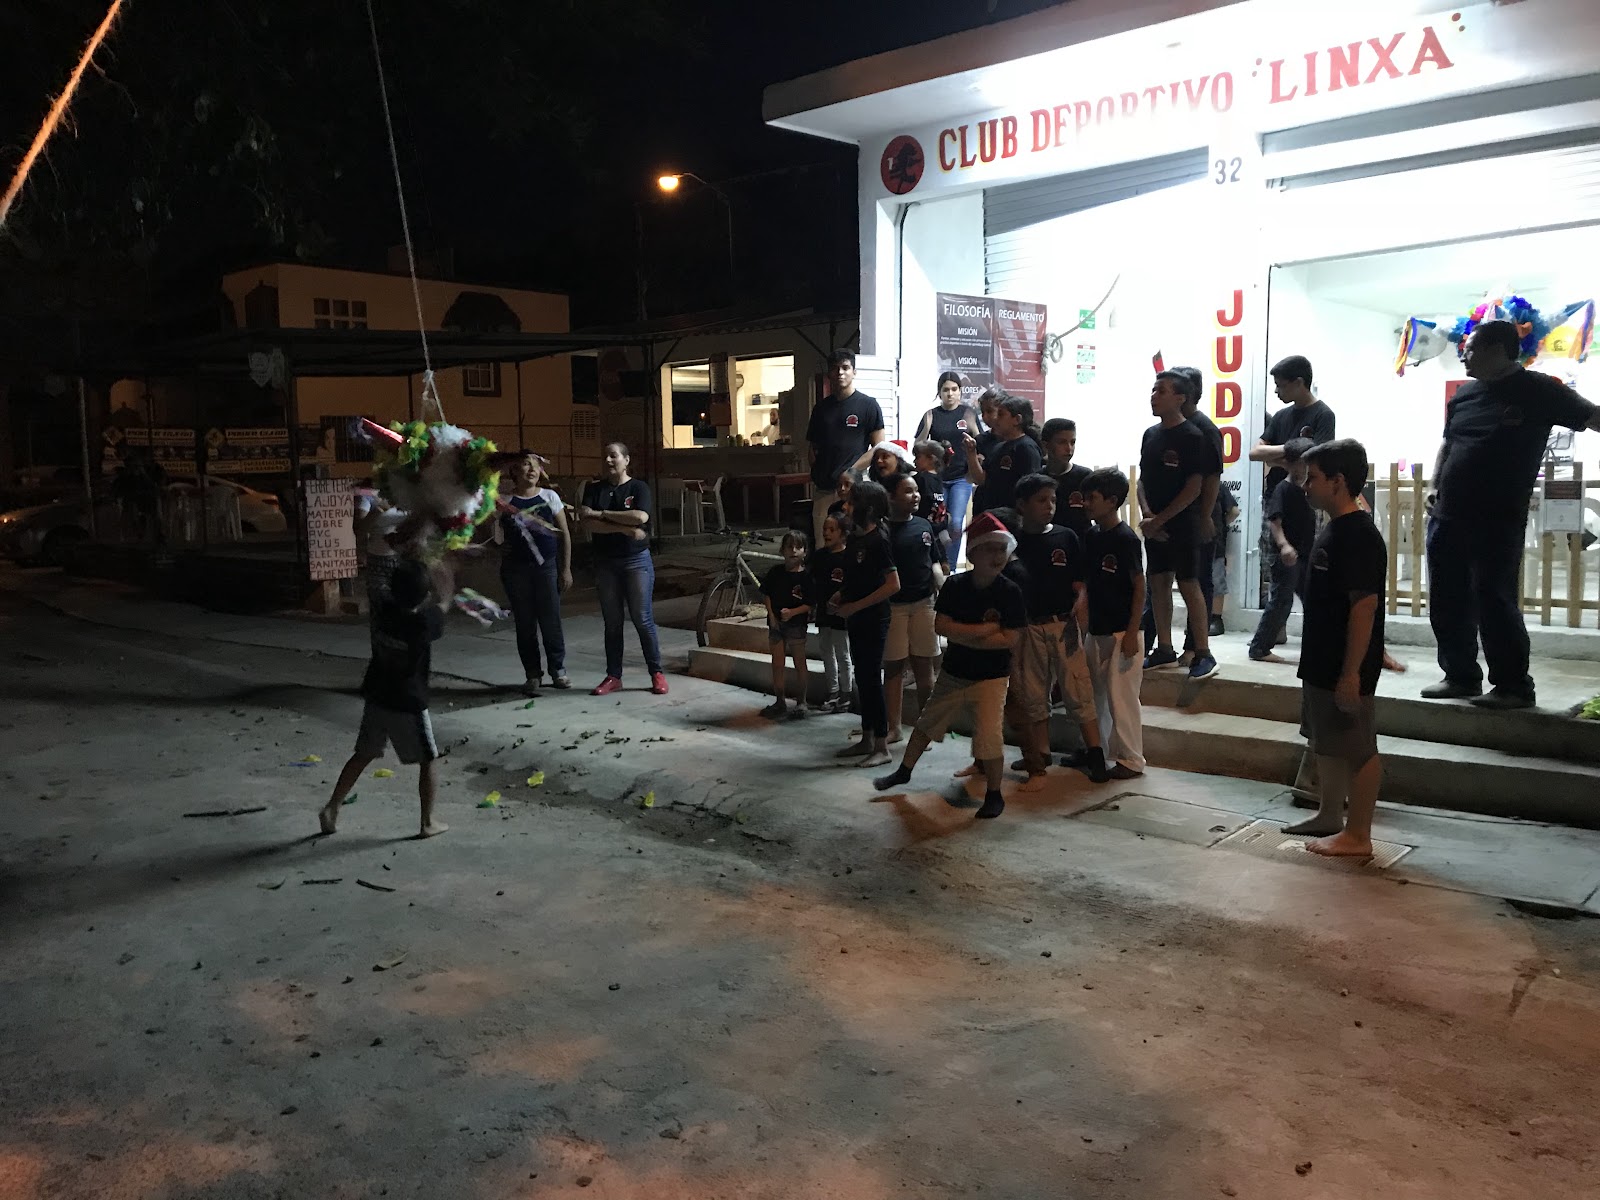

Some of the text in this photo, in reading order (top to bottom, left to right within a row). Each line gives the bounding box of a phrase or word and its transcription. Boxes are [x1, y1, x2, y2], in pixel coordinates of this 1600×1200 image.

[938, 115, 1019, 172] CLUB
[1030, 71, 1233, 153] DEPORTIVO
[1215, 156, 1242, 185] 32
[944, 303, 991, 319] FILOSOFÍA
[998, 309, 1045, 323] REGLAMENTO
[957, 327, 978, 336] MISIÓN
[958, 356, 978, 365] VISIÓN
[1214, 289, 1244, 464] JUDO
[307, 509, 354, 519] MATERIAL
[308, 519, 343, 529] COBRE
[309, 539, 340, 548] PLUS
